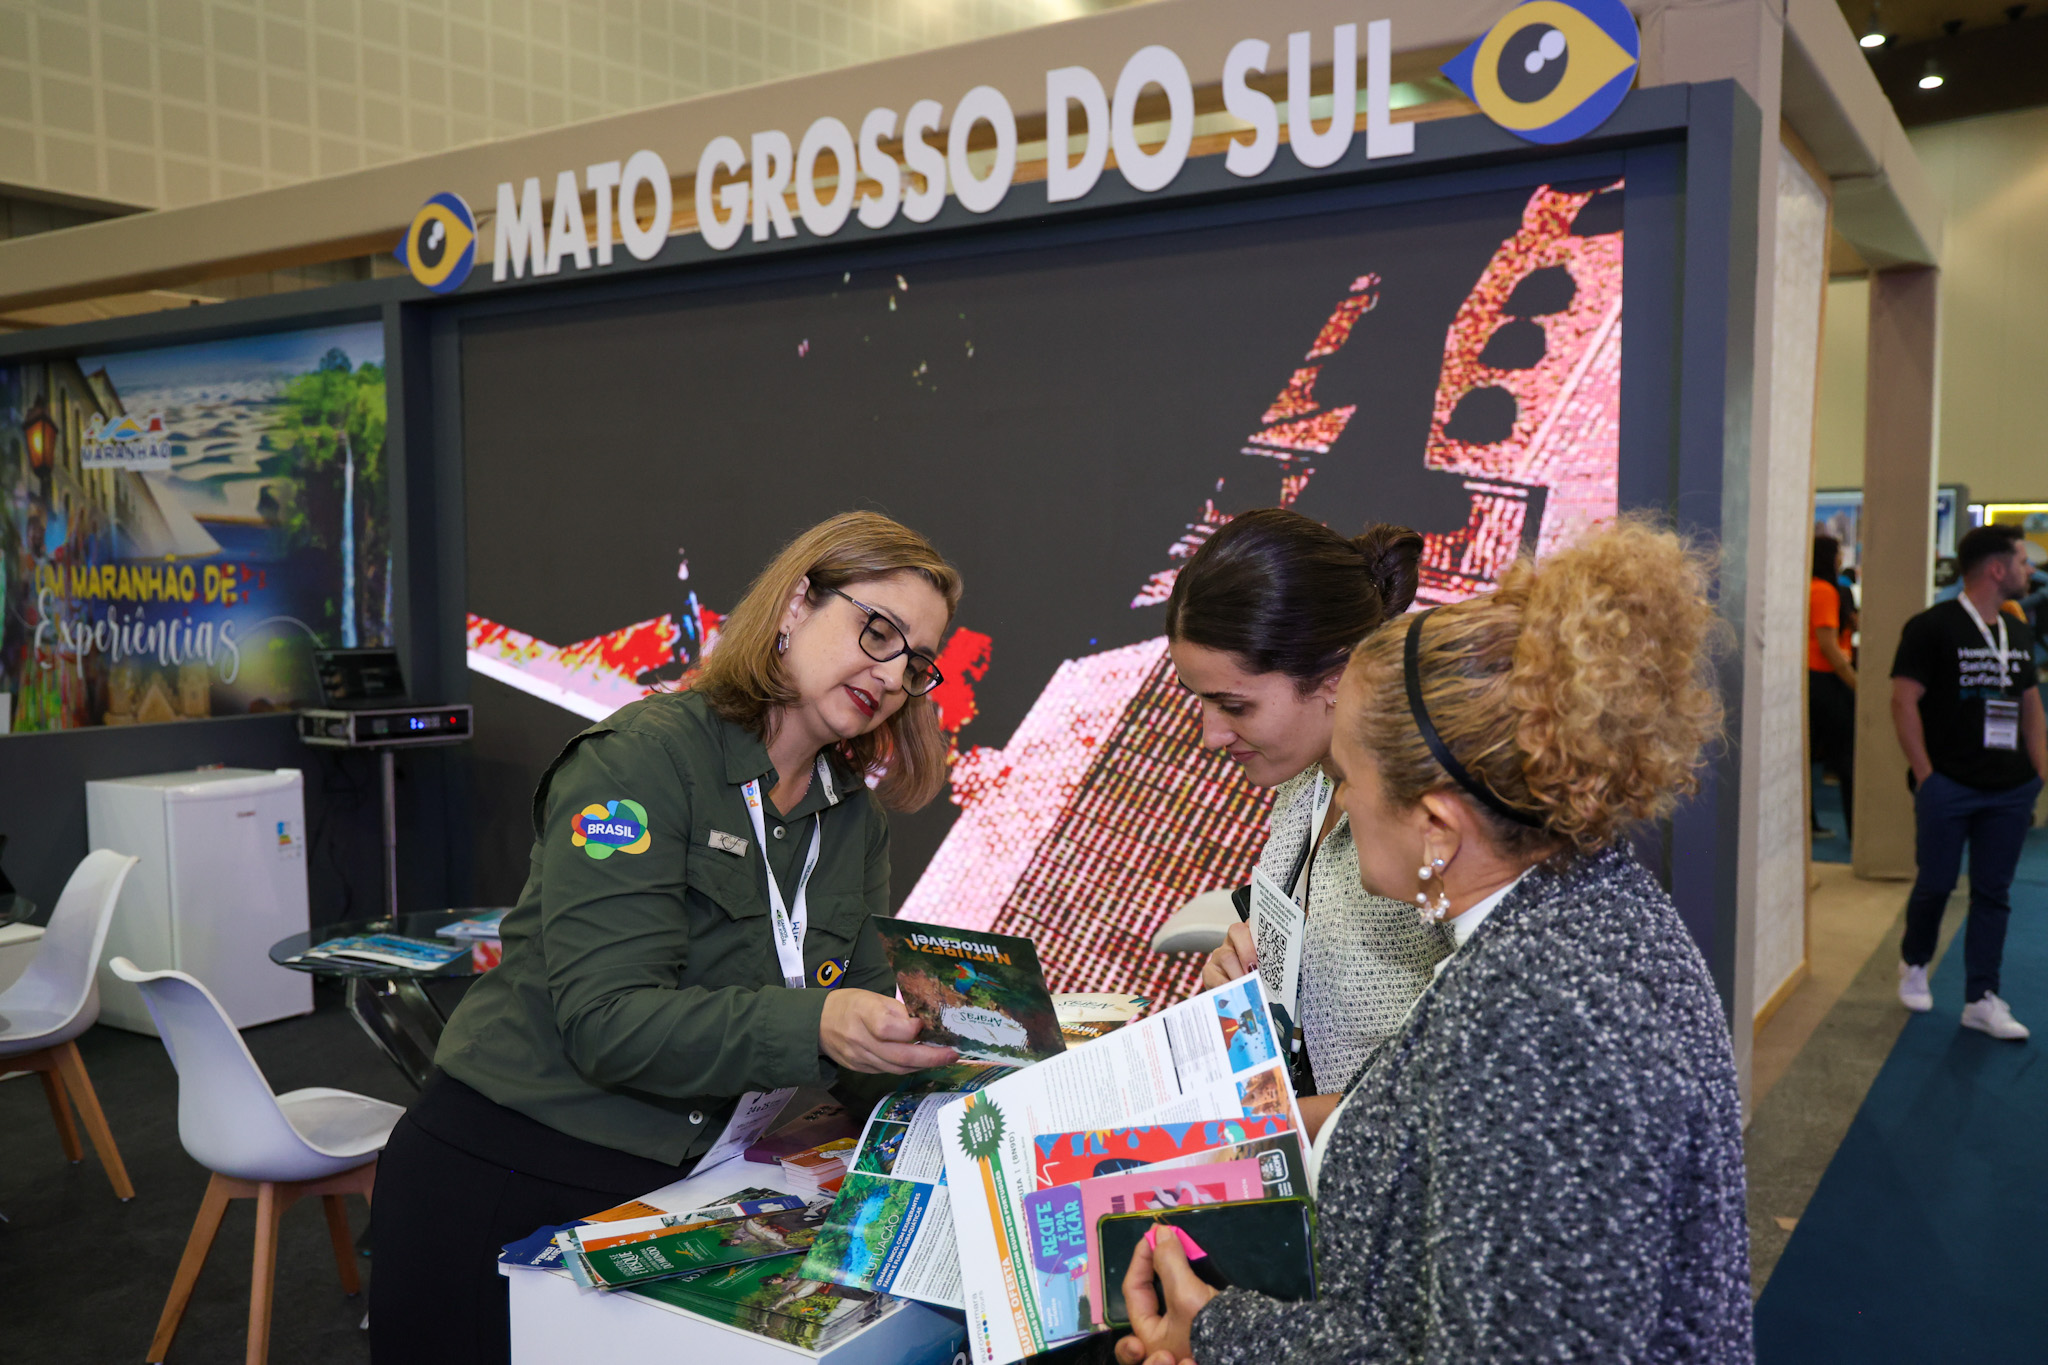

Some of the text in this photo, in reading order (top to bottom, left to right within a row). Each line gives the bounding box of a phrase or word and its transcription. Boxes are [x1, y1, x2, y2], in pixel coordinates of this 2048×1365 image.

[493, 19, 1415, 283] MATO GROSSO DO SUL
[35, 554, 238, 604] UM MARANHÃO DE
[35, 587, 241, 685] Experiências
[587, 823, 635, 838] BRASIL
[780, 918, 789, 939] CAMPOS
[911, 933, 999, 958] intocável
[905, 938, 1011, 965] NATUREZA
[960, 1012, 1002, 1027] Araras
[1061, 1024, 1099, 1034] intoc
[1061, 1027, 1103, 1038] NATU
[897, 1144, 908, 1169] NATUREZA
[910, 1118, 920, 1136] ALCANCE
[1009, 1131, 1020, 1165] (8N9D)
[994, 1170, 1010, 1214] PORTUGUÊS
[876, 1192, 922, 1287] CENÁRIO ÚNICO, COM EXUBERANTES
[1005, 1215, 1013, 1226] EM
[1008, 1227, 1017, 1249] GUIAS
[1036, 1201, 1059, 1257] RECIFE
[1055, 1211, 1068, 1241] É PRA
[1064, 1200, 1086, 1246] FICAR
[859, 1213, 900, 1284] FLUTUAÇÃO
[883, 1269, 895, 1288] FAUNA
[894, 1247, 905, 1265] FLORA
[902, 1206, 923, 1247] SUBAQUÁTICAS
[1013, 1251, 1023, 1268] COM
[1002, 1257, 1033, 1354] SUPER OFERTA
[1018, 1269, 1037, 1318] GARANTIDAS
[972, 1293, 987, 1363] euromarmara
[1032, 1319, 1045, 1349] SAIDAS
